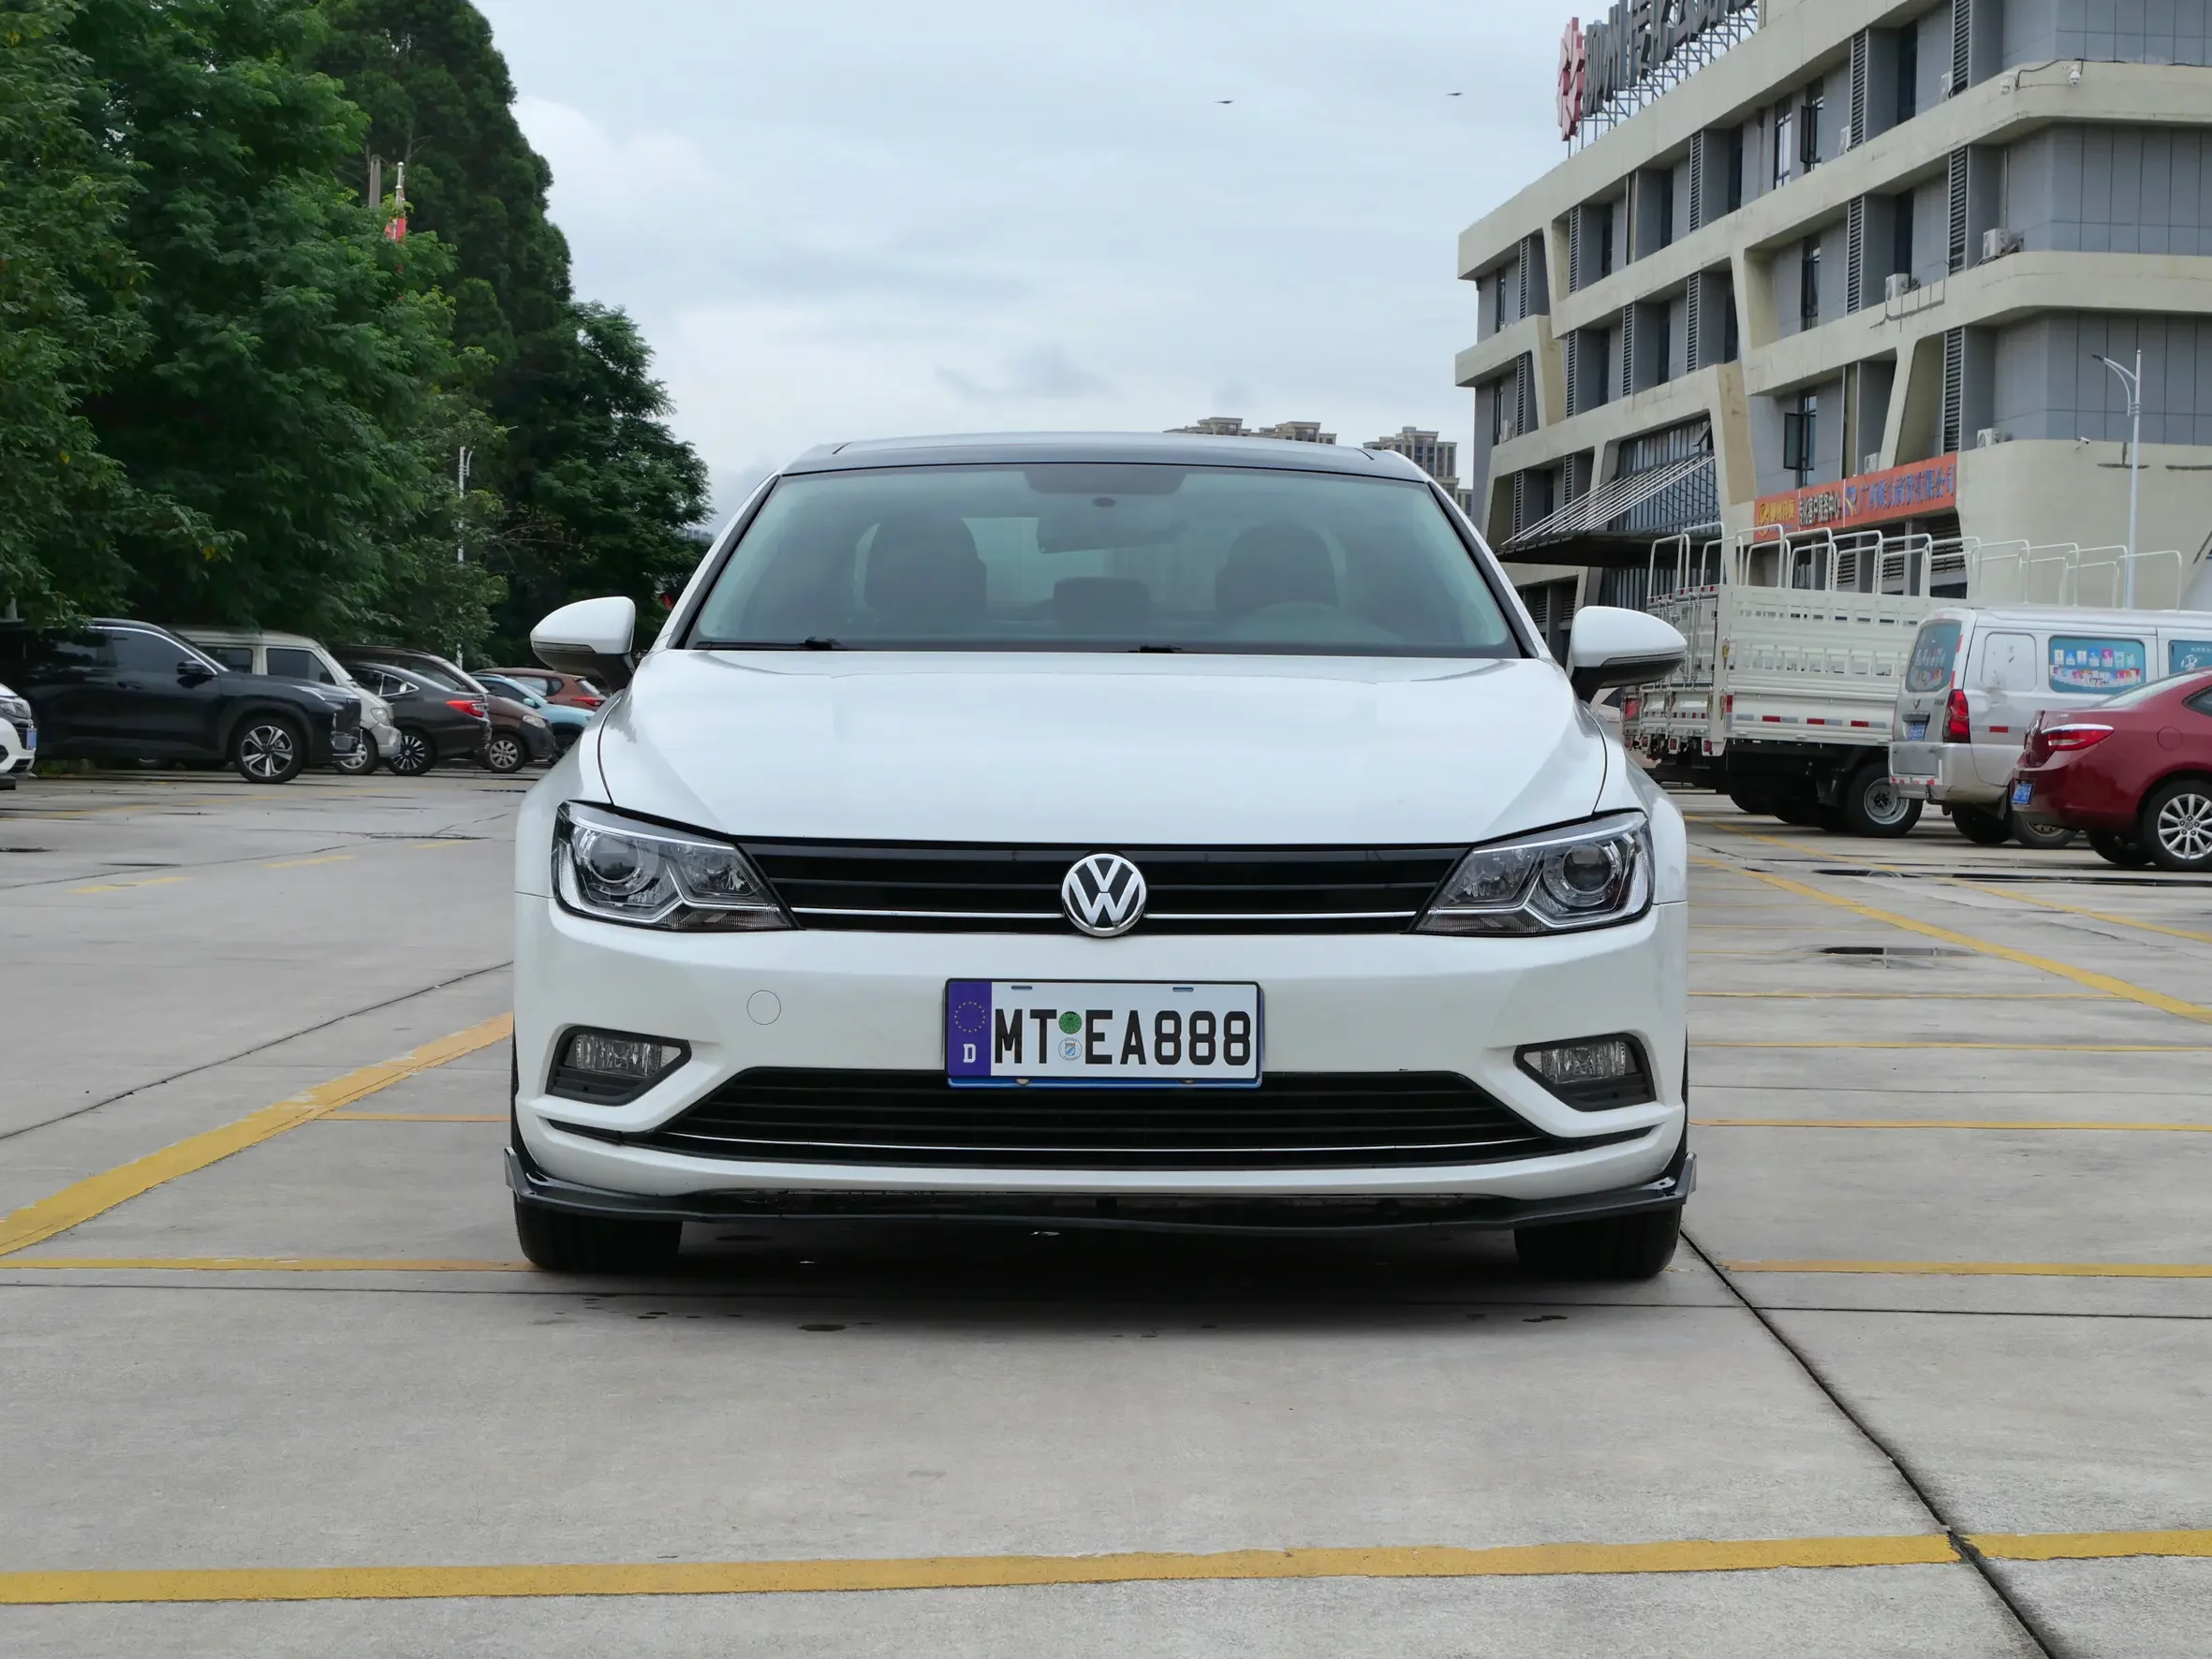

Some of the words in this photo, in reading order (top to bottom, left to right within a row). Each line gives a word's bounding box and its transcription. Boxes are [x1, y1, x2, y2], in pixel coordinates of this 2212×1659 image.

[1066, 856, 1143, 931] VW
[963, 1043, 977, 1064] D
[995, 1008, 1057, 1064] MT
[1084, 1009, 1251, 1065] EA888
